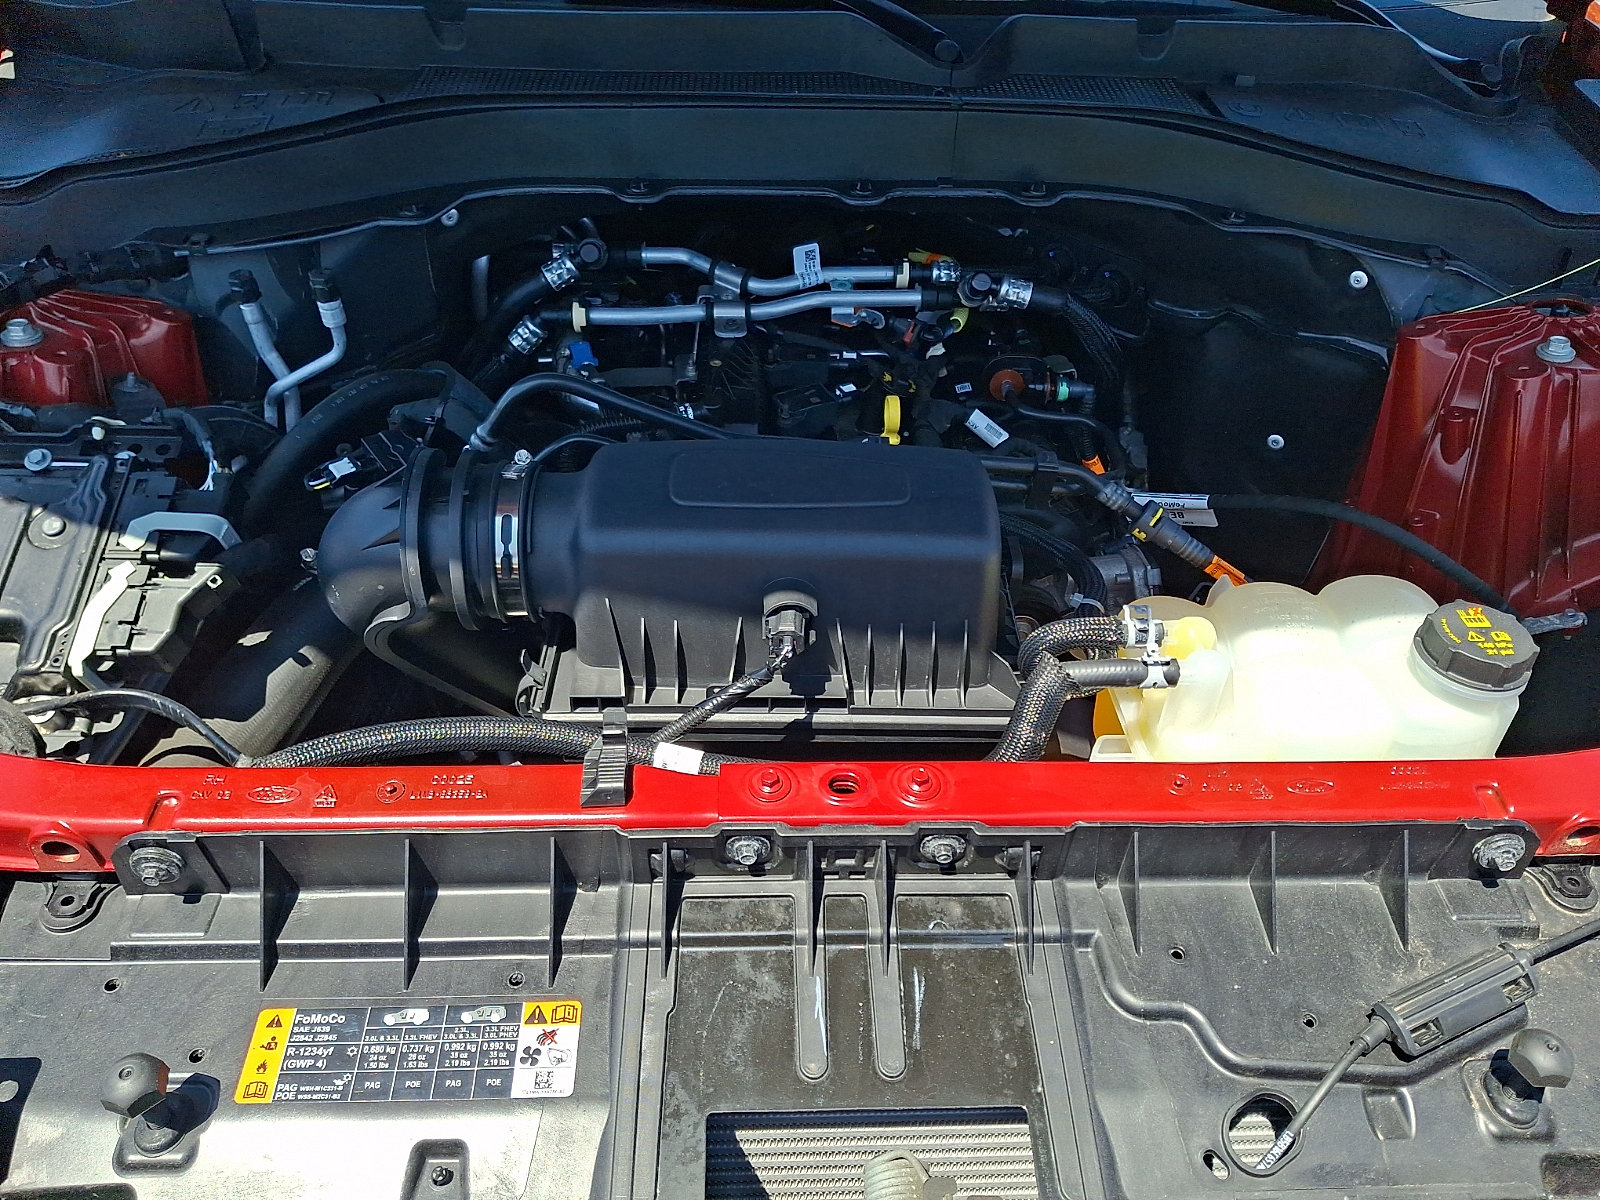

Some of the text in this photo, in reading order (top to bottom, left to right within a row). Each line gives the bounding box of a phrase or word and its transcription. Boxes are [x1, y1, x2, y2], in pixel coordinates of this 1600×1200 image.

[295, 1013, 345, 1024] FoMoCo
[287, 1046, 334, 1057] R-1234yf
[386, 1045, 397, 1054] kg
[424, 1044, 435, 1054] kg
[444, 1043, 477, 1052] 0.992 kg
[483, 1042, 516, 1052] 0.992 kg
[283, 1059, 326, 1070] (GWP 4)
[274, 1092, 297, 1100] POE
